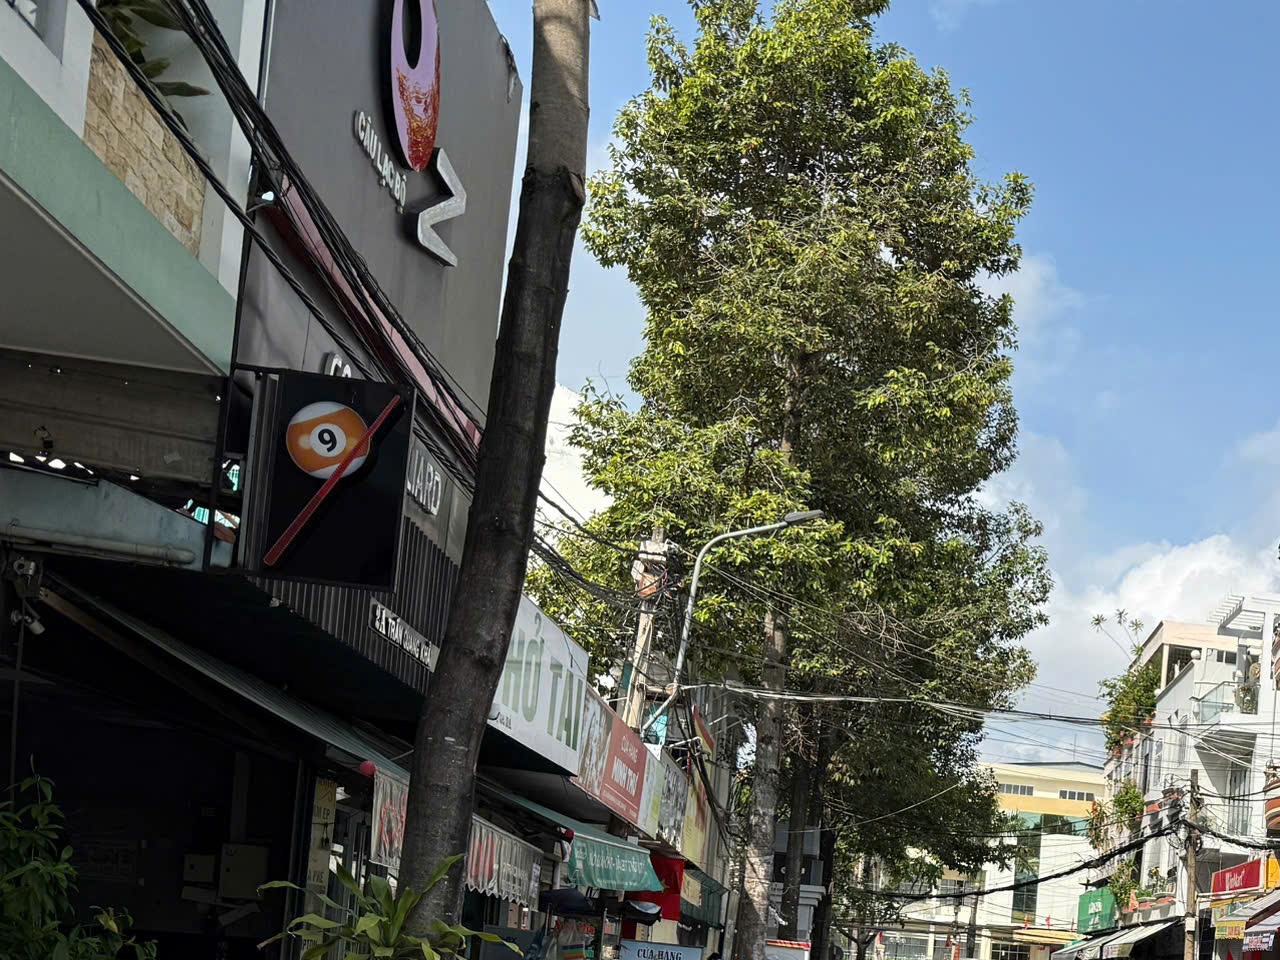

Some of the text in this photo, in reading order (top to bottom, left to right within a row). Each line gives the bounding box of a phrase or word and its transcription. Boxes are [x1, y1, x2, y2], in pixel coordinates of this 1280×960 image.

[317, 428, 338, 453] 9
[500, 612, 545, 723] HỞ
[657, 949, 682, 960] HÀNG
